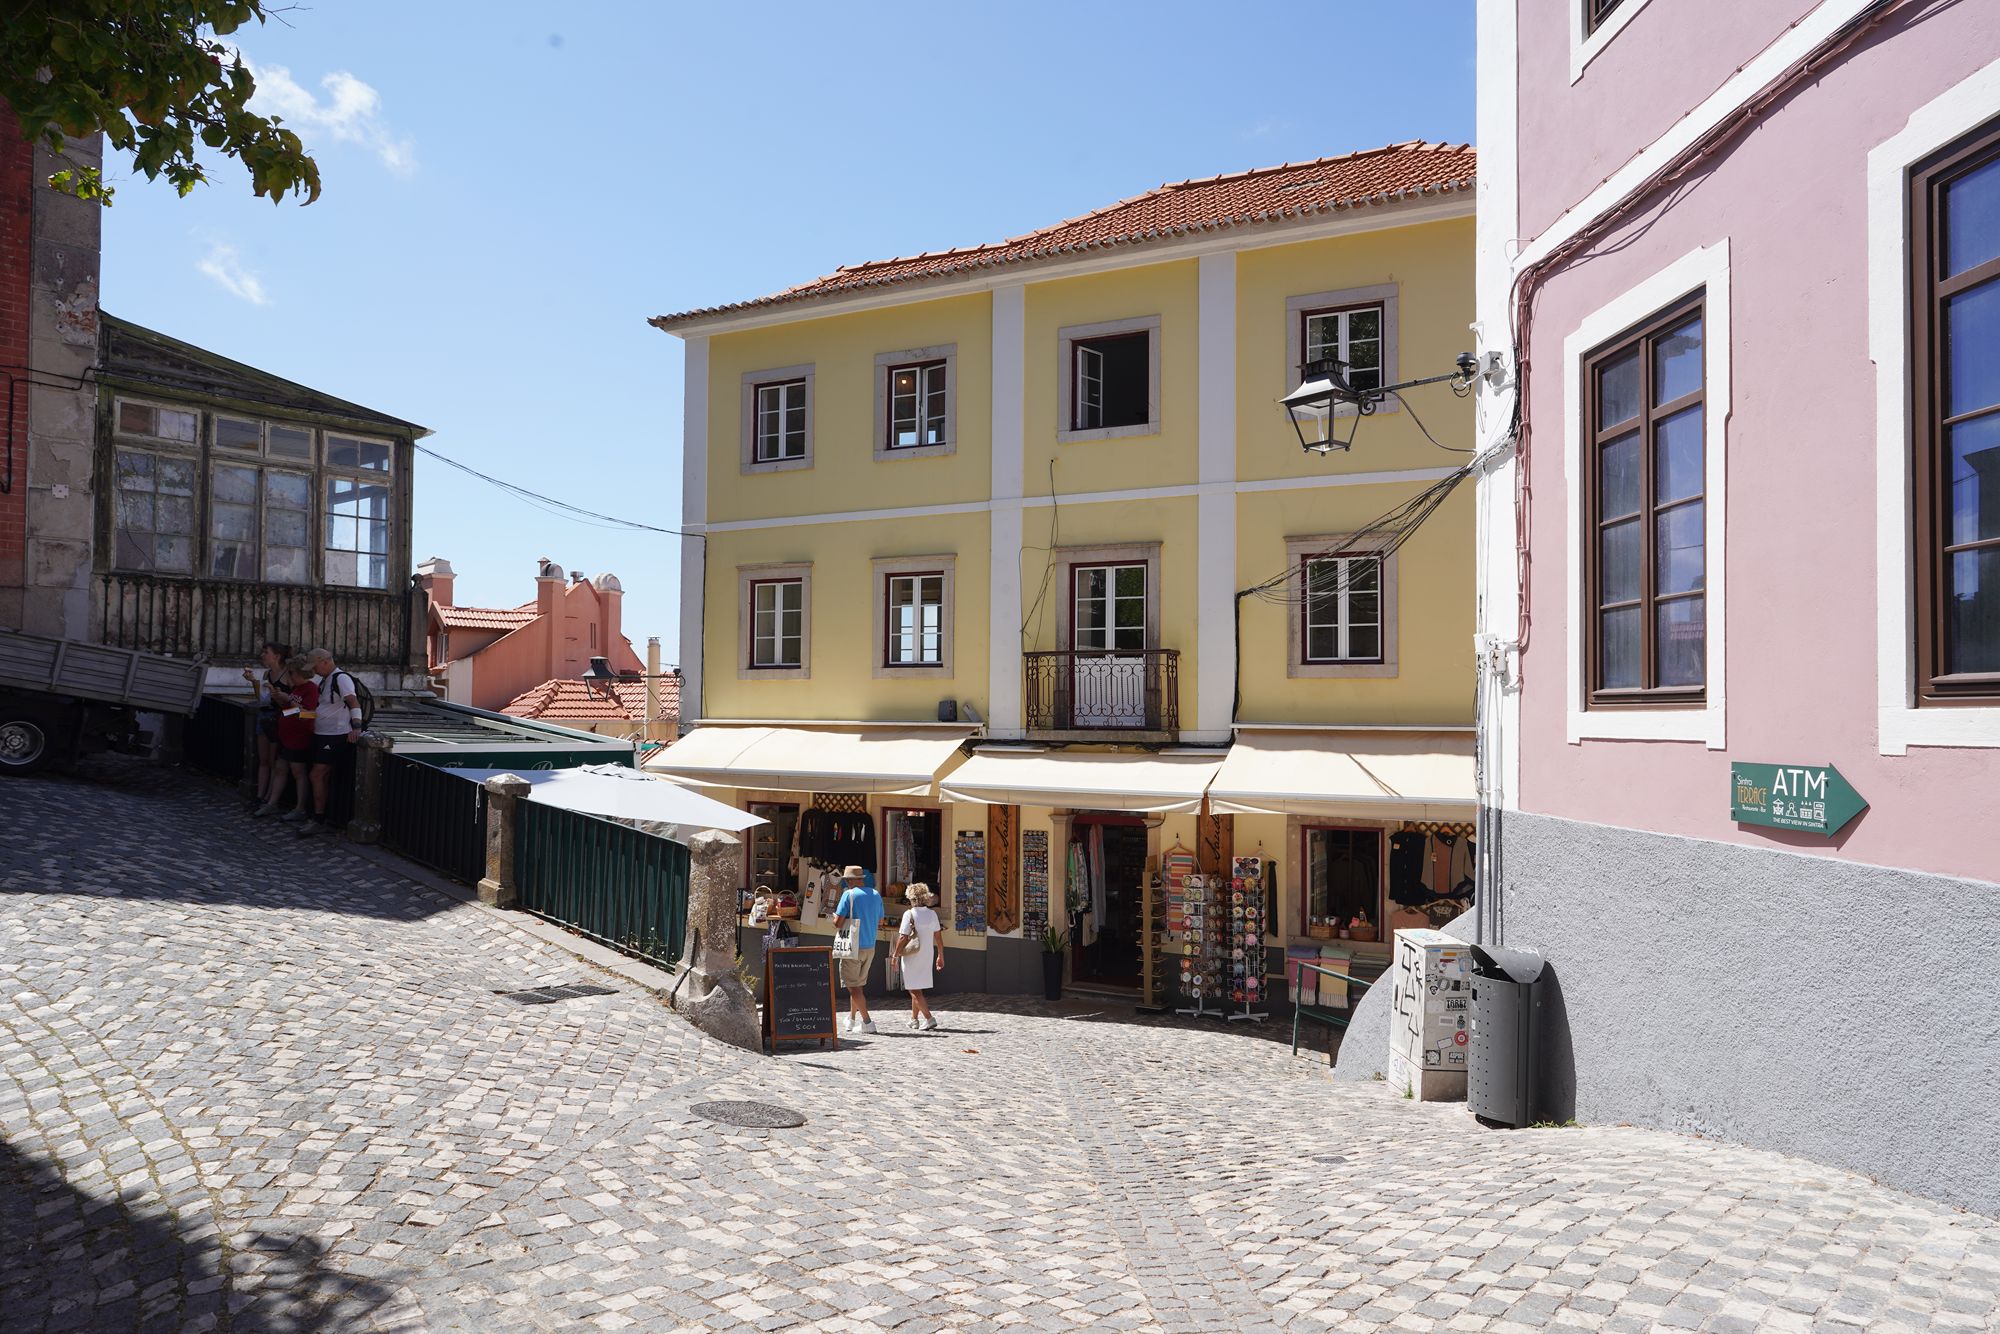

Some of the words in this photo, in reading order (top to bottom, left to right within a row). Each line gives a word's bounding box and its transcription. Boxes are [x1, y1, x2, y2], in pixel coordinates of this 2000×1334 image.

[1737, 775, 1753, 786] Sintra
[1773, 768, 1825, 799] ATM
[1737, 785, 1767, 805] TERRACE
